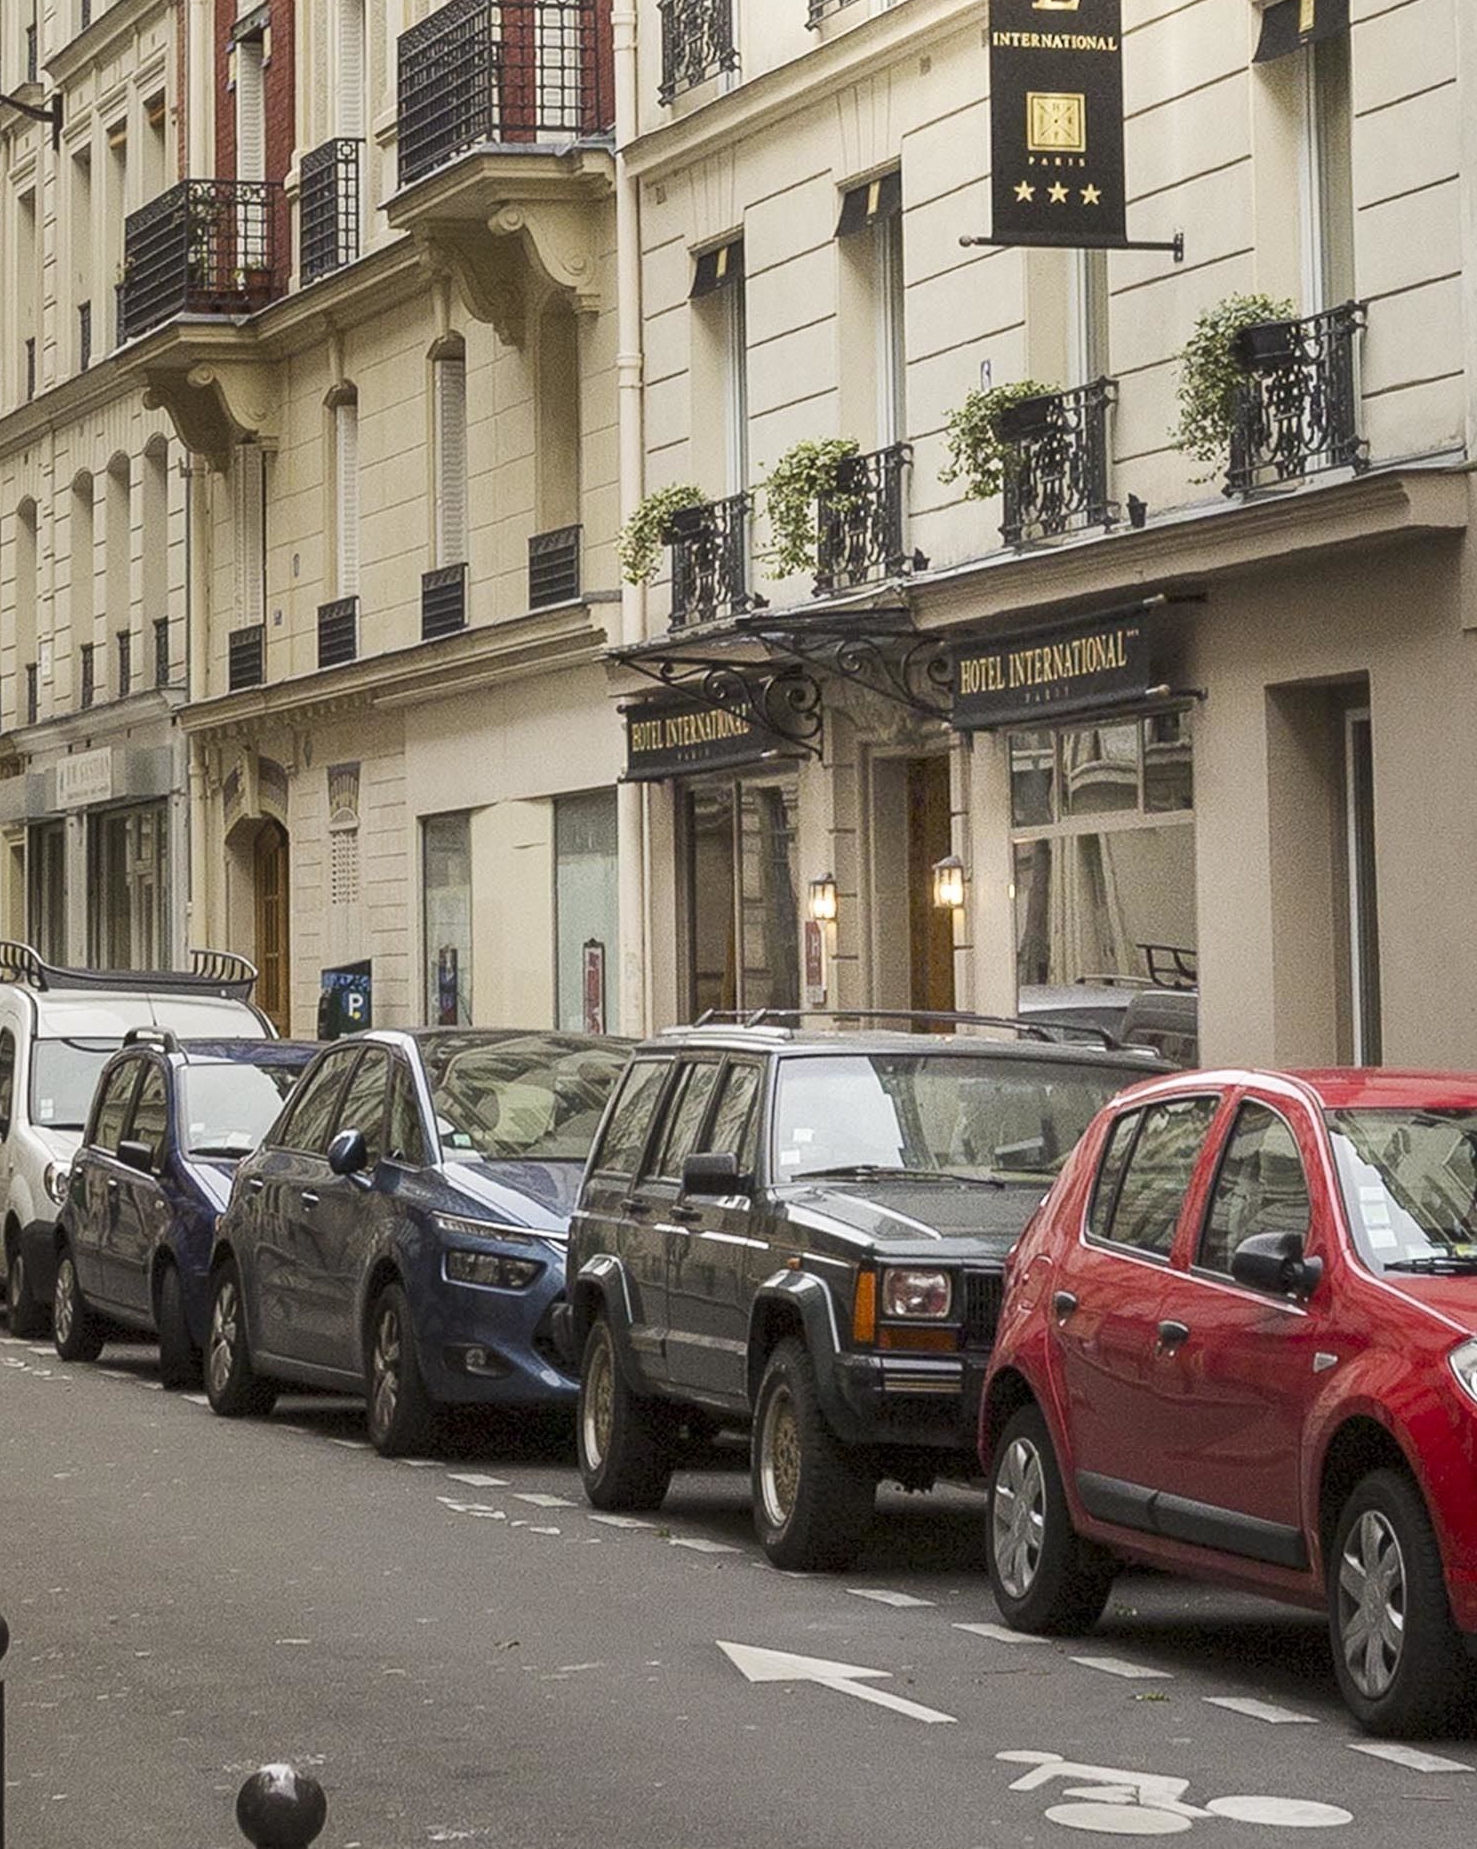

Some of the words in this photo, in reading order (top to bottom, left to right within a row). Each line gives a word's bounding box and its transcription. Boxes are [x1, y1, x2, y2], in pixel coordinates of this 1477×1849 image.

[992, 32, 1118, 51] INTERNATIONAL
[1028, 156, 1086, 168] PARIS
[960, 656, 1005, 694] HOTEL
[1009, 630, 1127, 688] INTERNATIONAL
[631, 720, 664, 752] HOTEL
[348, 993, 363, 1017] P
